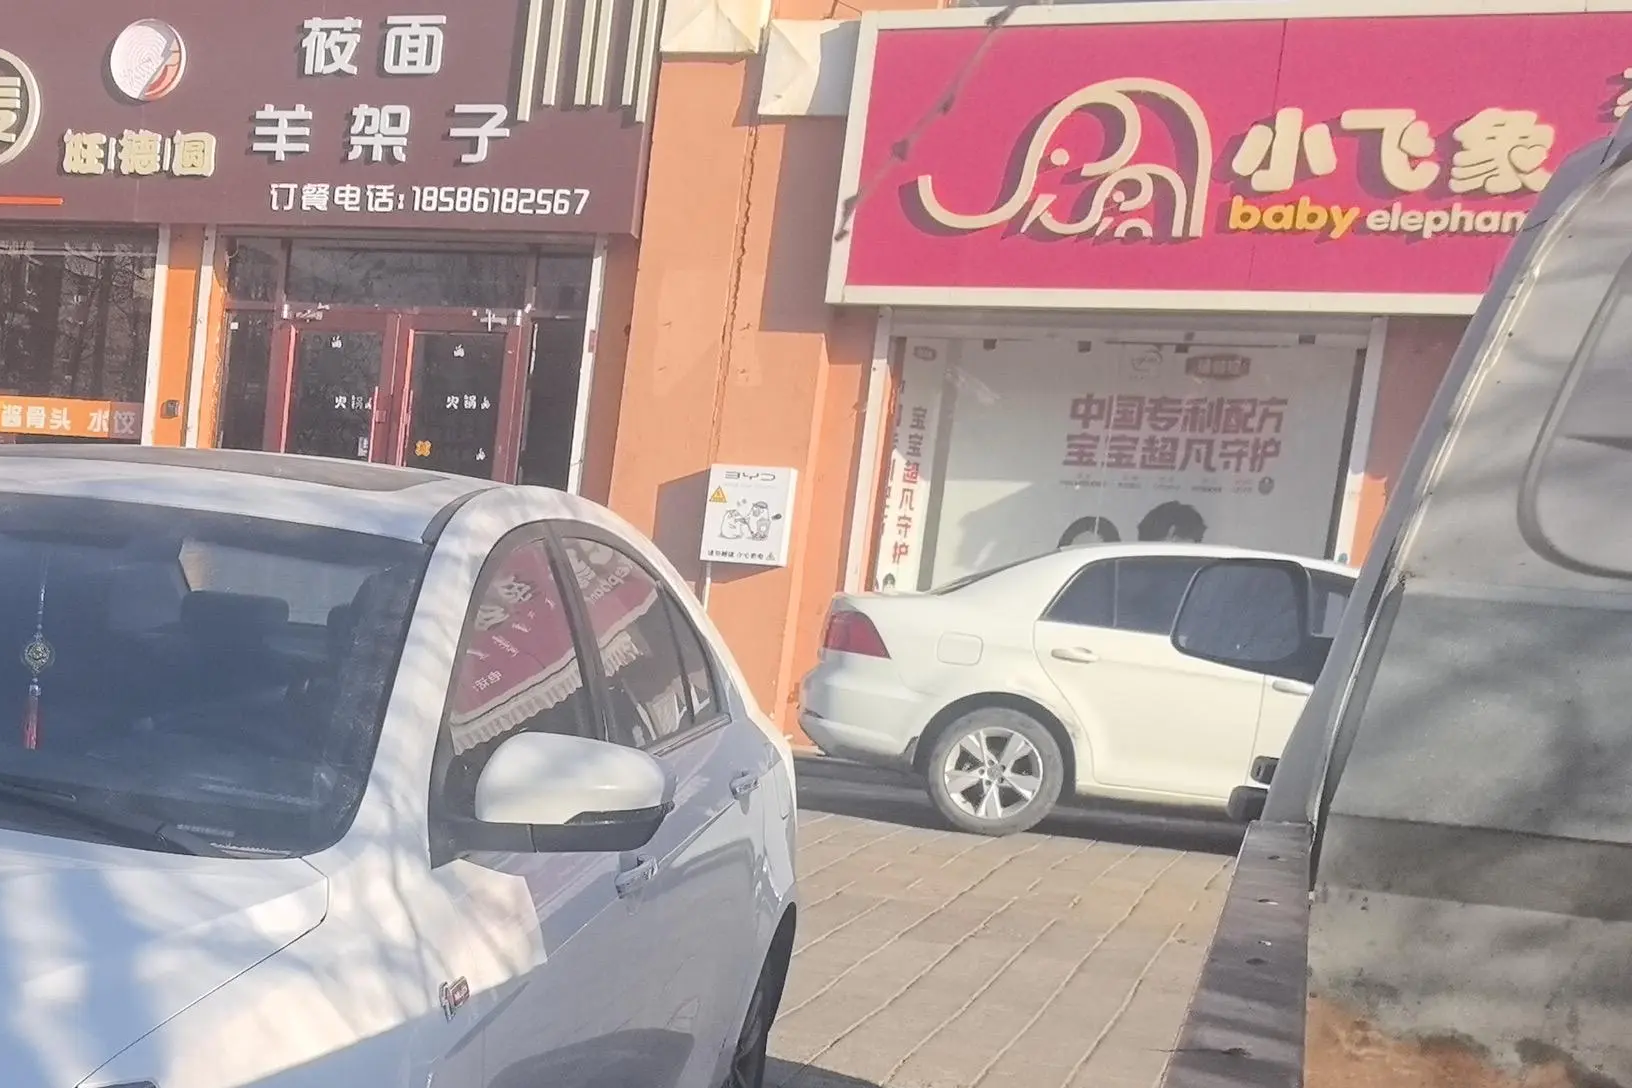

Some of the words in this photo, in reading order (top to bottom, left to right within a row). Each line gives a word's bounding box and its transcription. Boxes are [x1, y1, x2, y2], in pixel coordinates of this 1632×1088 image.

[302, 15, 447, 75] 莜面
[253, 103, 510, 164] 羊架子
[1231, 107, 1555, 193] 小飞象
[1229, 195, 1361, 238] baby
[1366, 201, 1530, 239] elephan
[1, 403, 72, 431] 酱骨头
[87, 409, 136, 436] 水饺
[446, 393, 477, 410] 火锅
[1070, 393, 1289, 434] 中国专利配方
[1062, 432, 1282, 473] 宝宝超凡守护
[724, 471, 776, 481] BYD
[891, 406, 928, 564] 宝宝超凡守护
